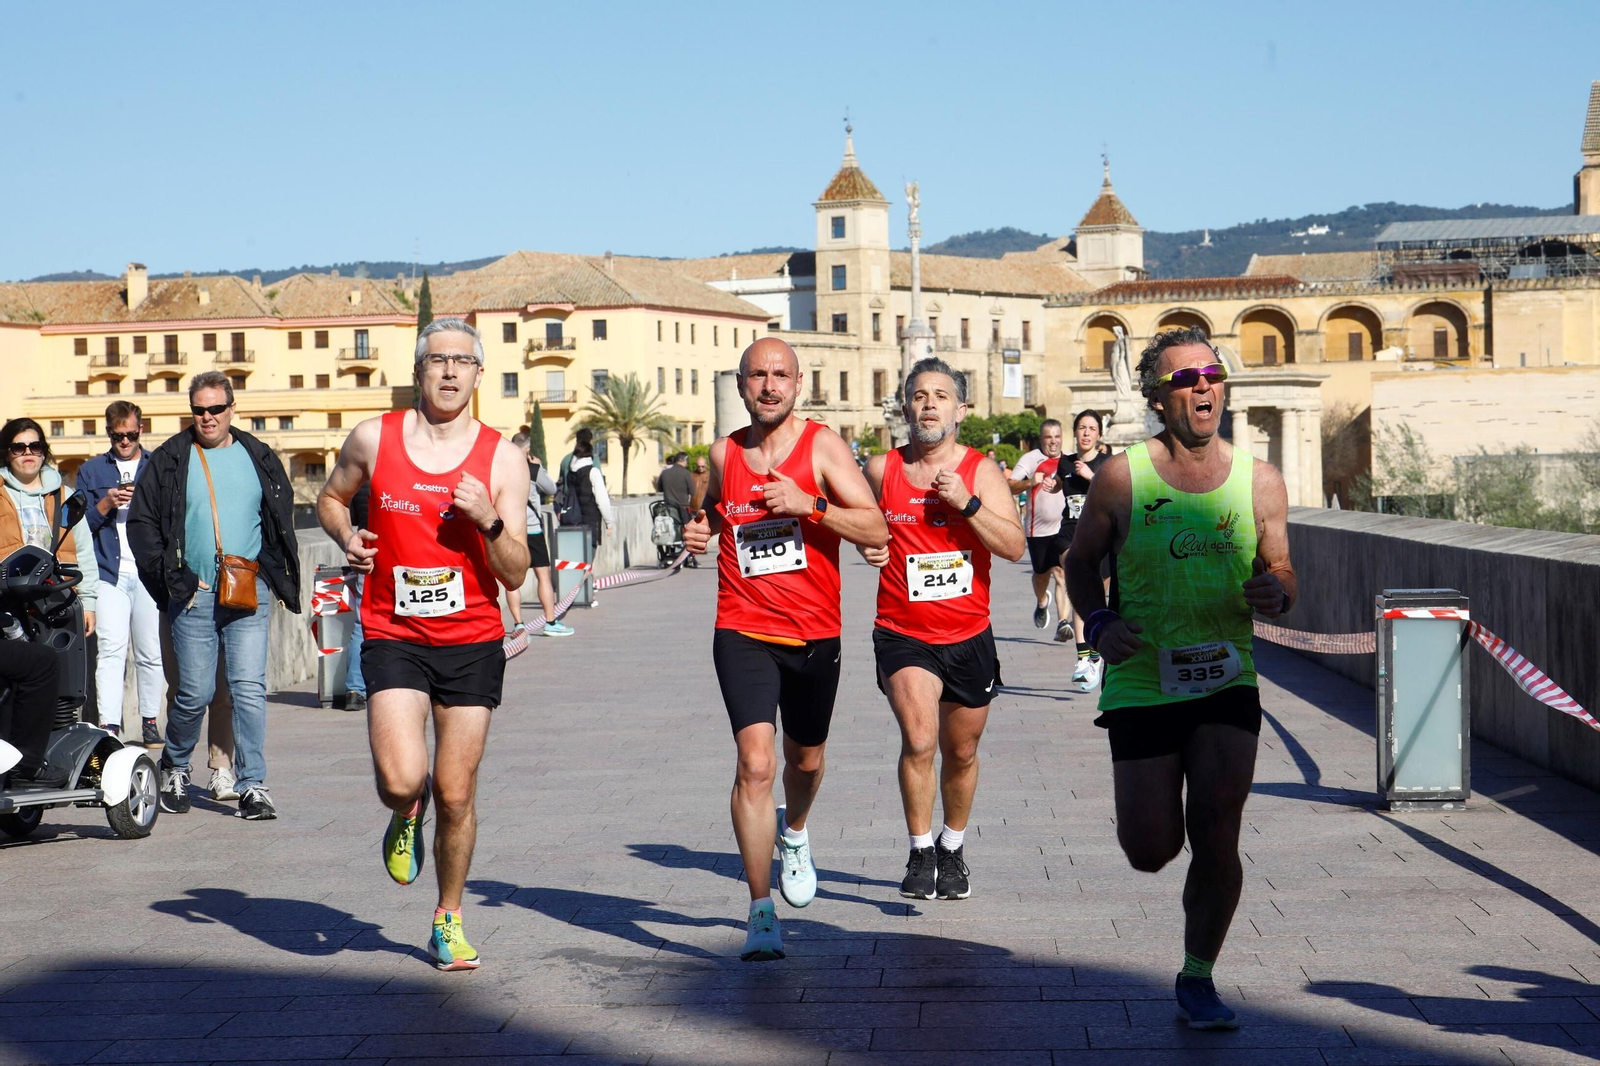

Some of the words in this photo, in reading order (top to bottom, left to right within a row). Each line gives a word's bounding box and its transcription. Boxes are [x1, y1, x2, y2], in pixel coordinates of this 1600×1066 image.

[749, 542, 787, 560] 110
[924, 572, 958, 587] 214
[409, 587, 448, 603] 125
[1177, 664, 1225, 681] 335
